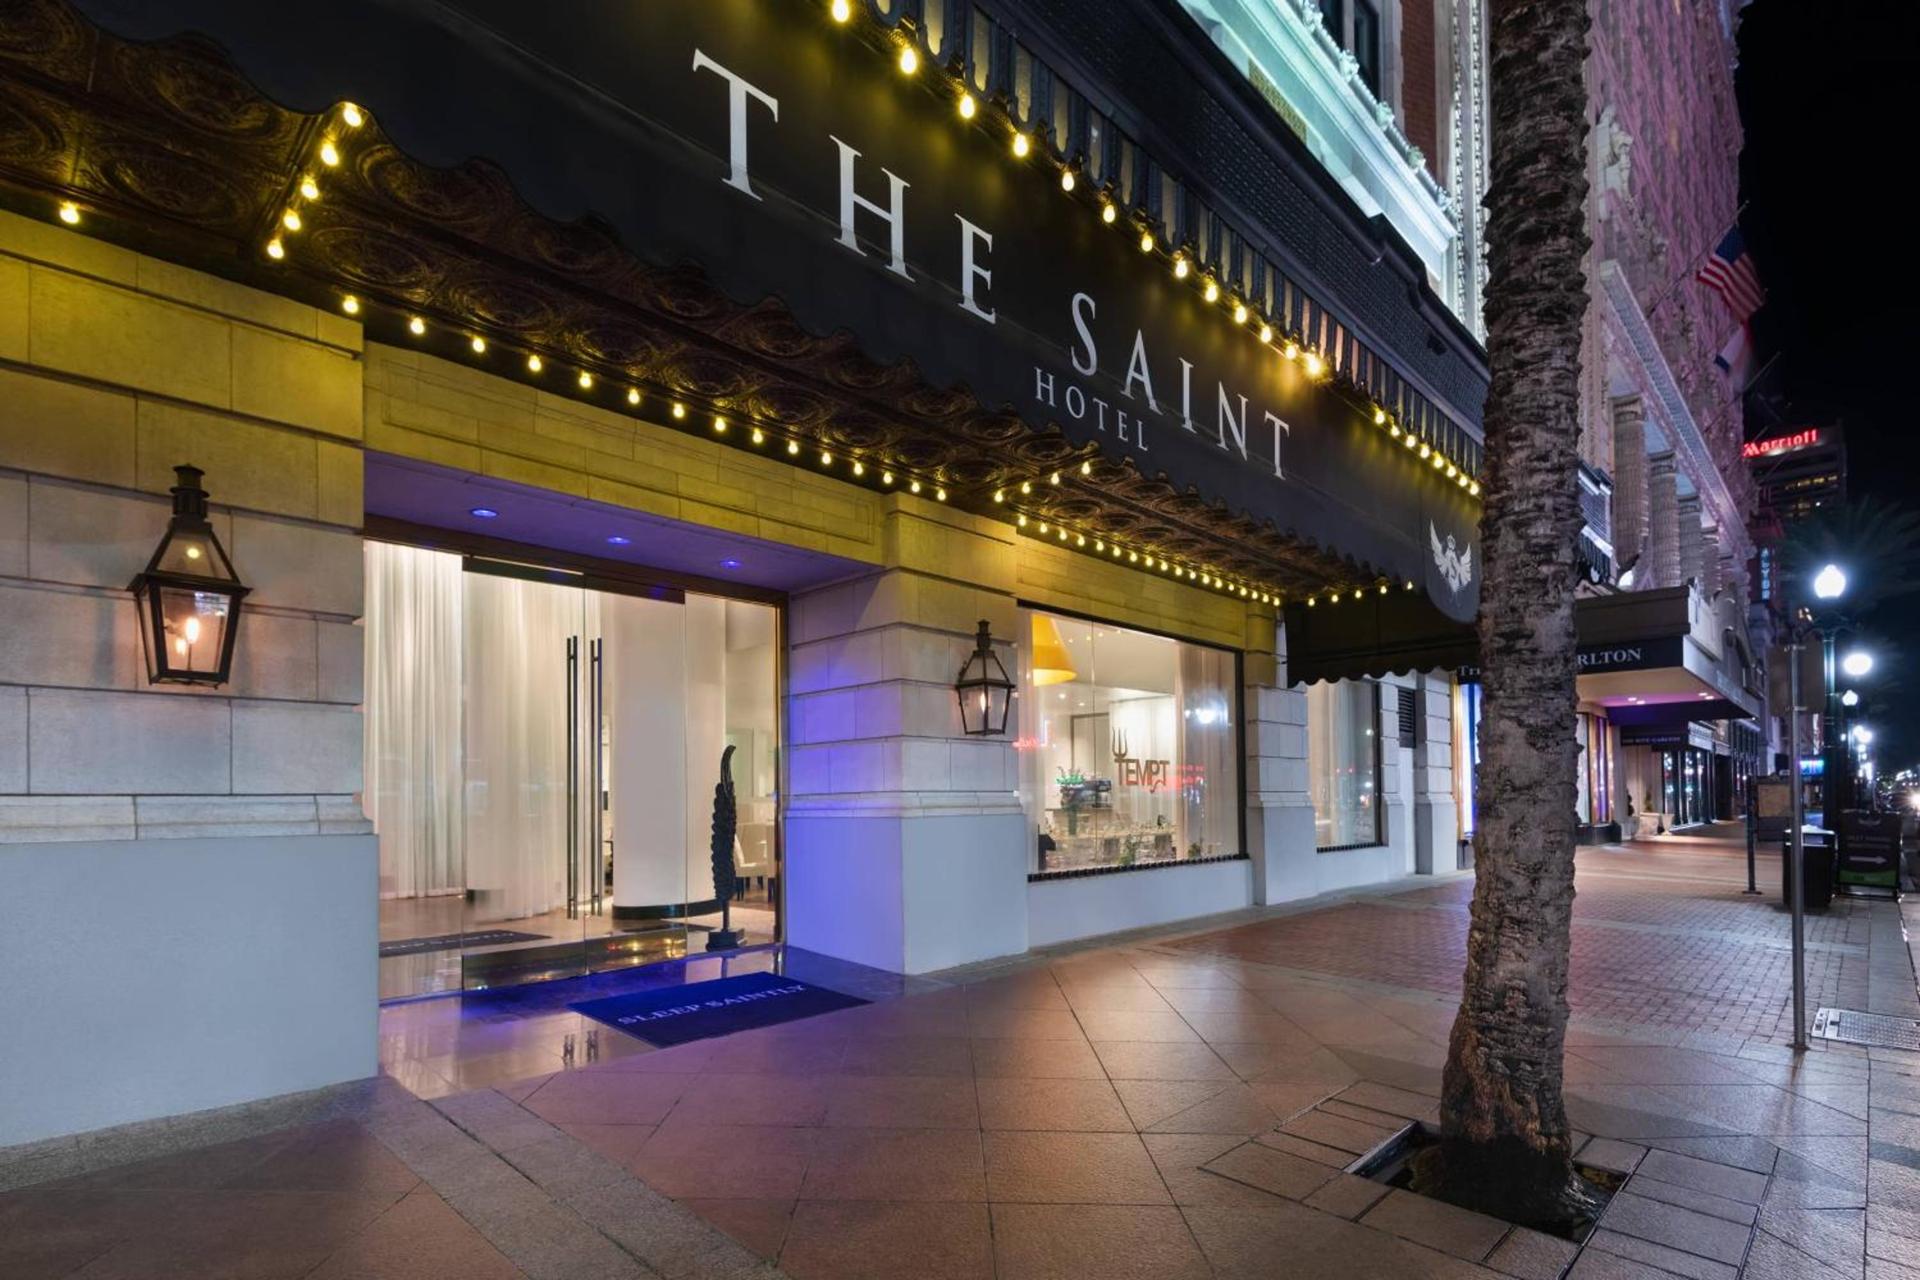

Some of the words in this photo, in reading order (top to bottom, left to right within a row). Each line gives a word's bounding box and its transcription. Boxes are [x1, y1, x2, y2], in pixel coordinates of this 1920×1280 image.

[693, 47, 996, 325] THE
[1071, 291, 1290, 480] SAINT
[1033, 366, 1149, 452] HOTEL
[1743, 429, 1817, 457] Marriott
[1576, 648, 1642, 666] RLTON
[617, 1004, 700, 1025] SLEEP
[704, 985, 806, 1007] SAINTLY
